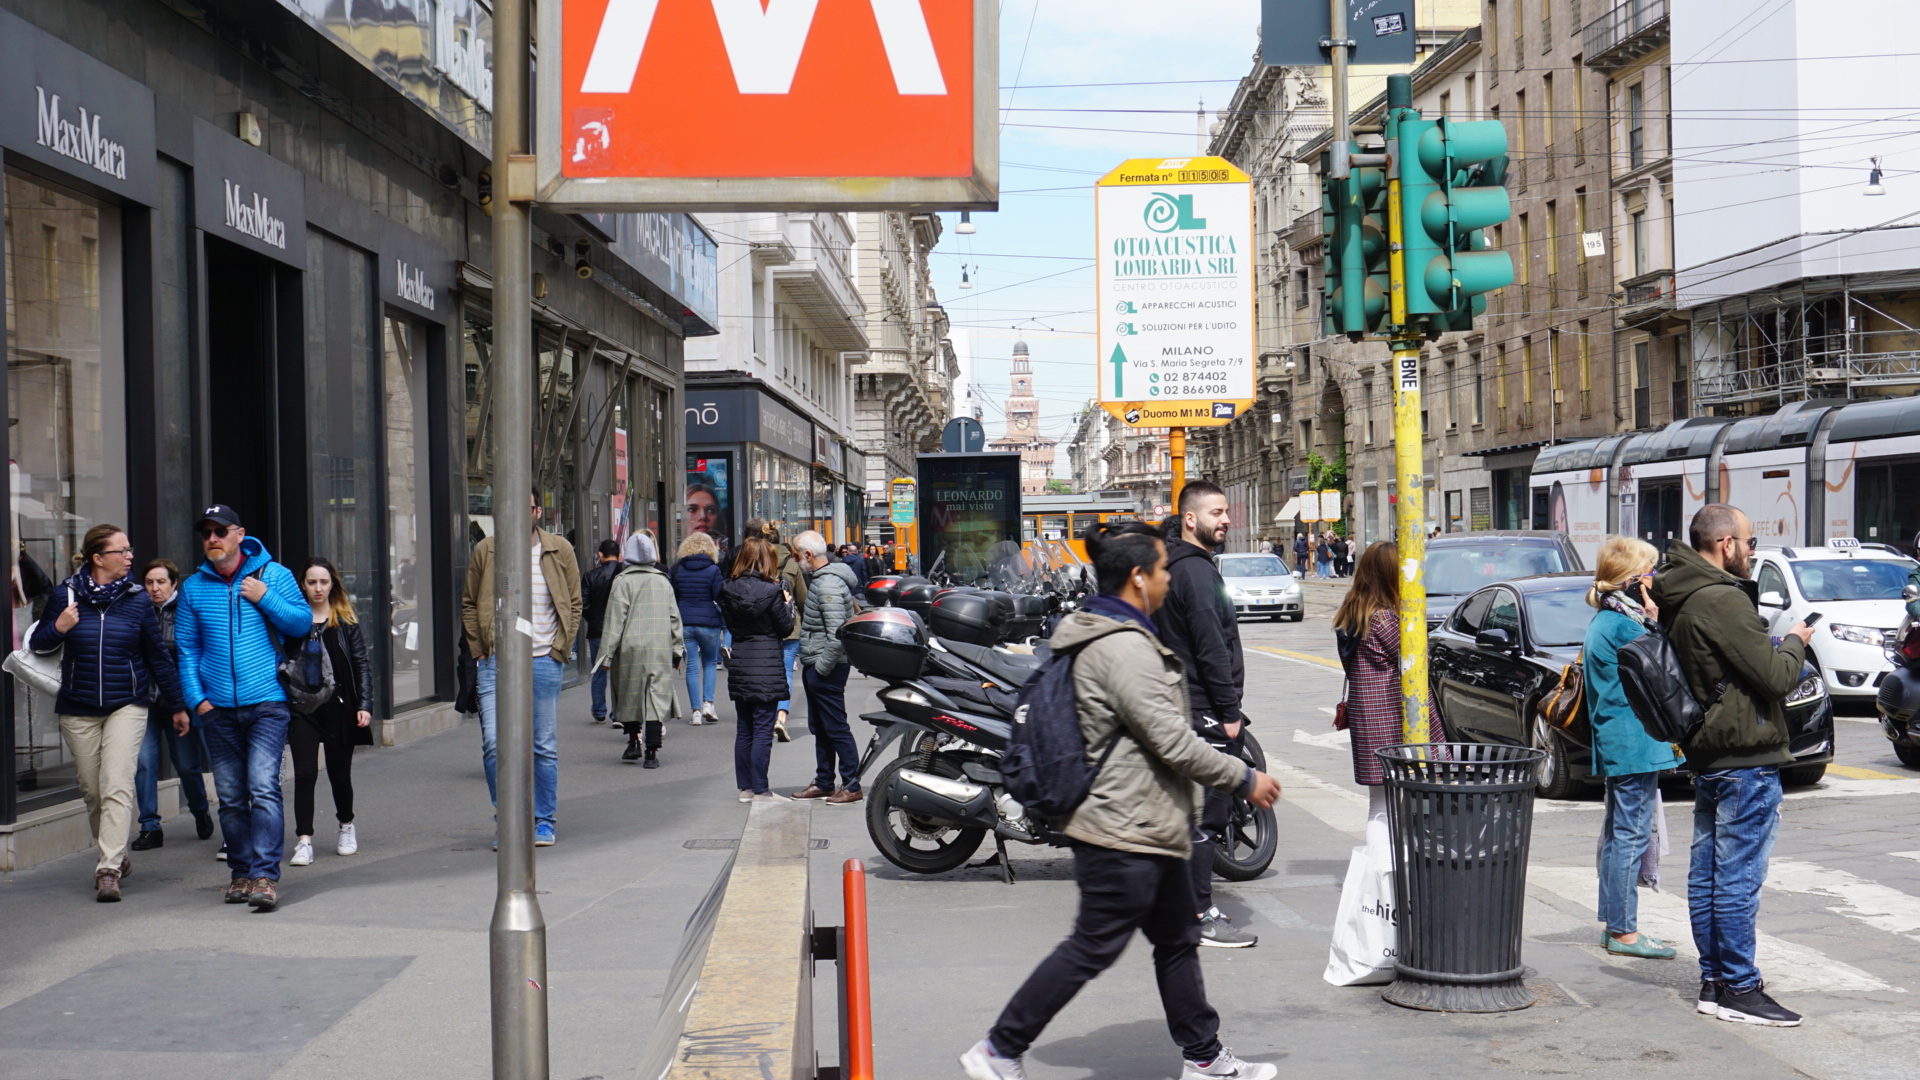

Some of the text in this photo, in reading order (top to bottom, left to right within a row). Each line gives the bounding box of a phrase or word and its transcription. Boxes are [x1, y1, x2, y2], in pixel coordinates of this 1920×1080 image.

[35, 85, 126, 180] MaxMara
[1120, 173, 1160, 182] Fermata
[224, 178, 286, 250] MaxMara
[1113, 234, 1237, 257] OTOACUSTICA
[1586, 240, 1602, 249] 195
[1114, 256, 1238, 277] LOMBARDA SRL
[396, 258, 435, 311] MaxMara
[1113, 280, 1238, 293] CENTRO OTOACUSTICO
[1141, 300, 1237, 310] APPARECCHI ACUSTICI
[1141, 322, 1237, 332] SOLUZIONI PER L'UDITO
[1161, 346, 1214, 356] MILANO
[1133, 357, 1244, 369] Via S. Maria Segreta 7/9
[1163, 371, 1227, 382] 02 874402
[1401, 359, 1418, 389] BNE
[1163, 384, 1228, 395] 02 866908
[1142, 408, 1178, 418] Duomo
[1180, 408, 1193, 418] M1
[1194, 408, 1210, 418] M3
[936, 489, 1003, 502] LEONARDO
[946, 500, 994, 511] mai visto
[1752, 516, 1770, 537] AFFÈ
[1832, 539, 1858, 548] TAXI
